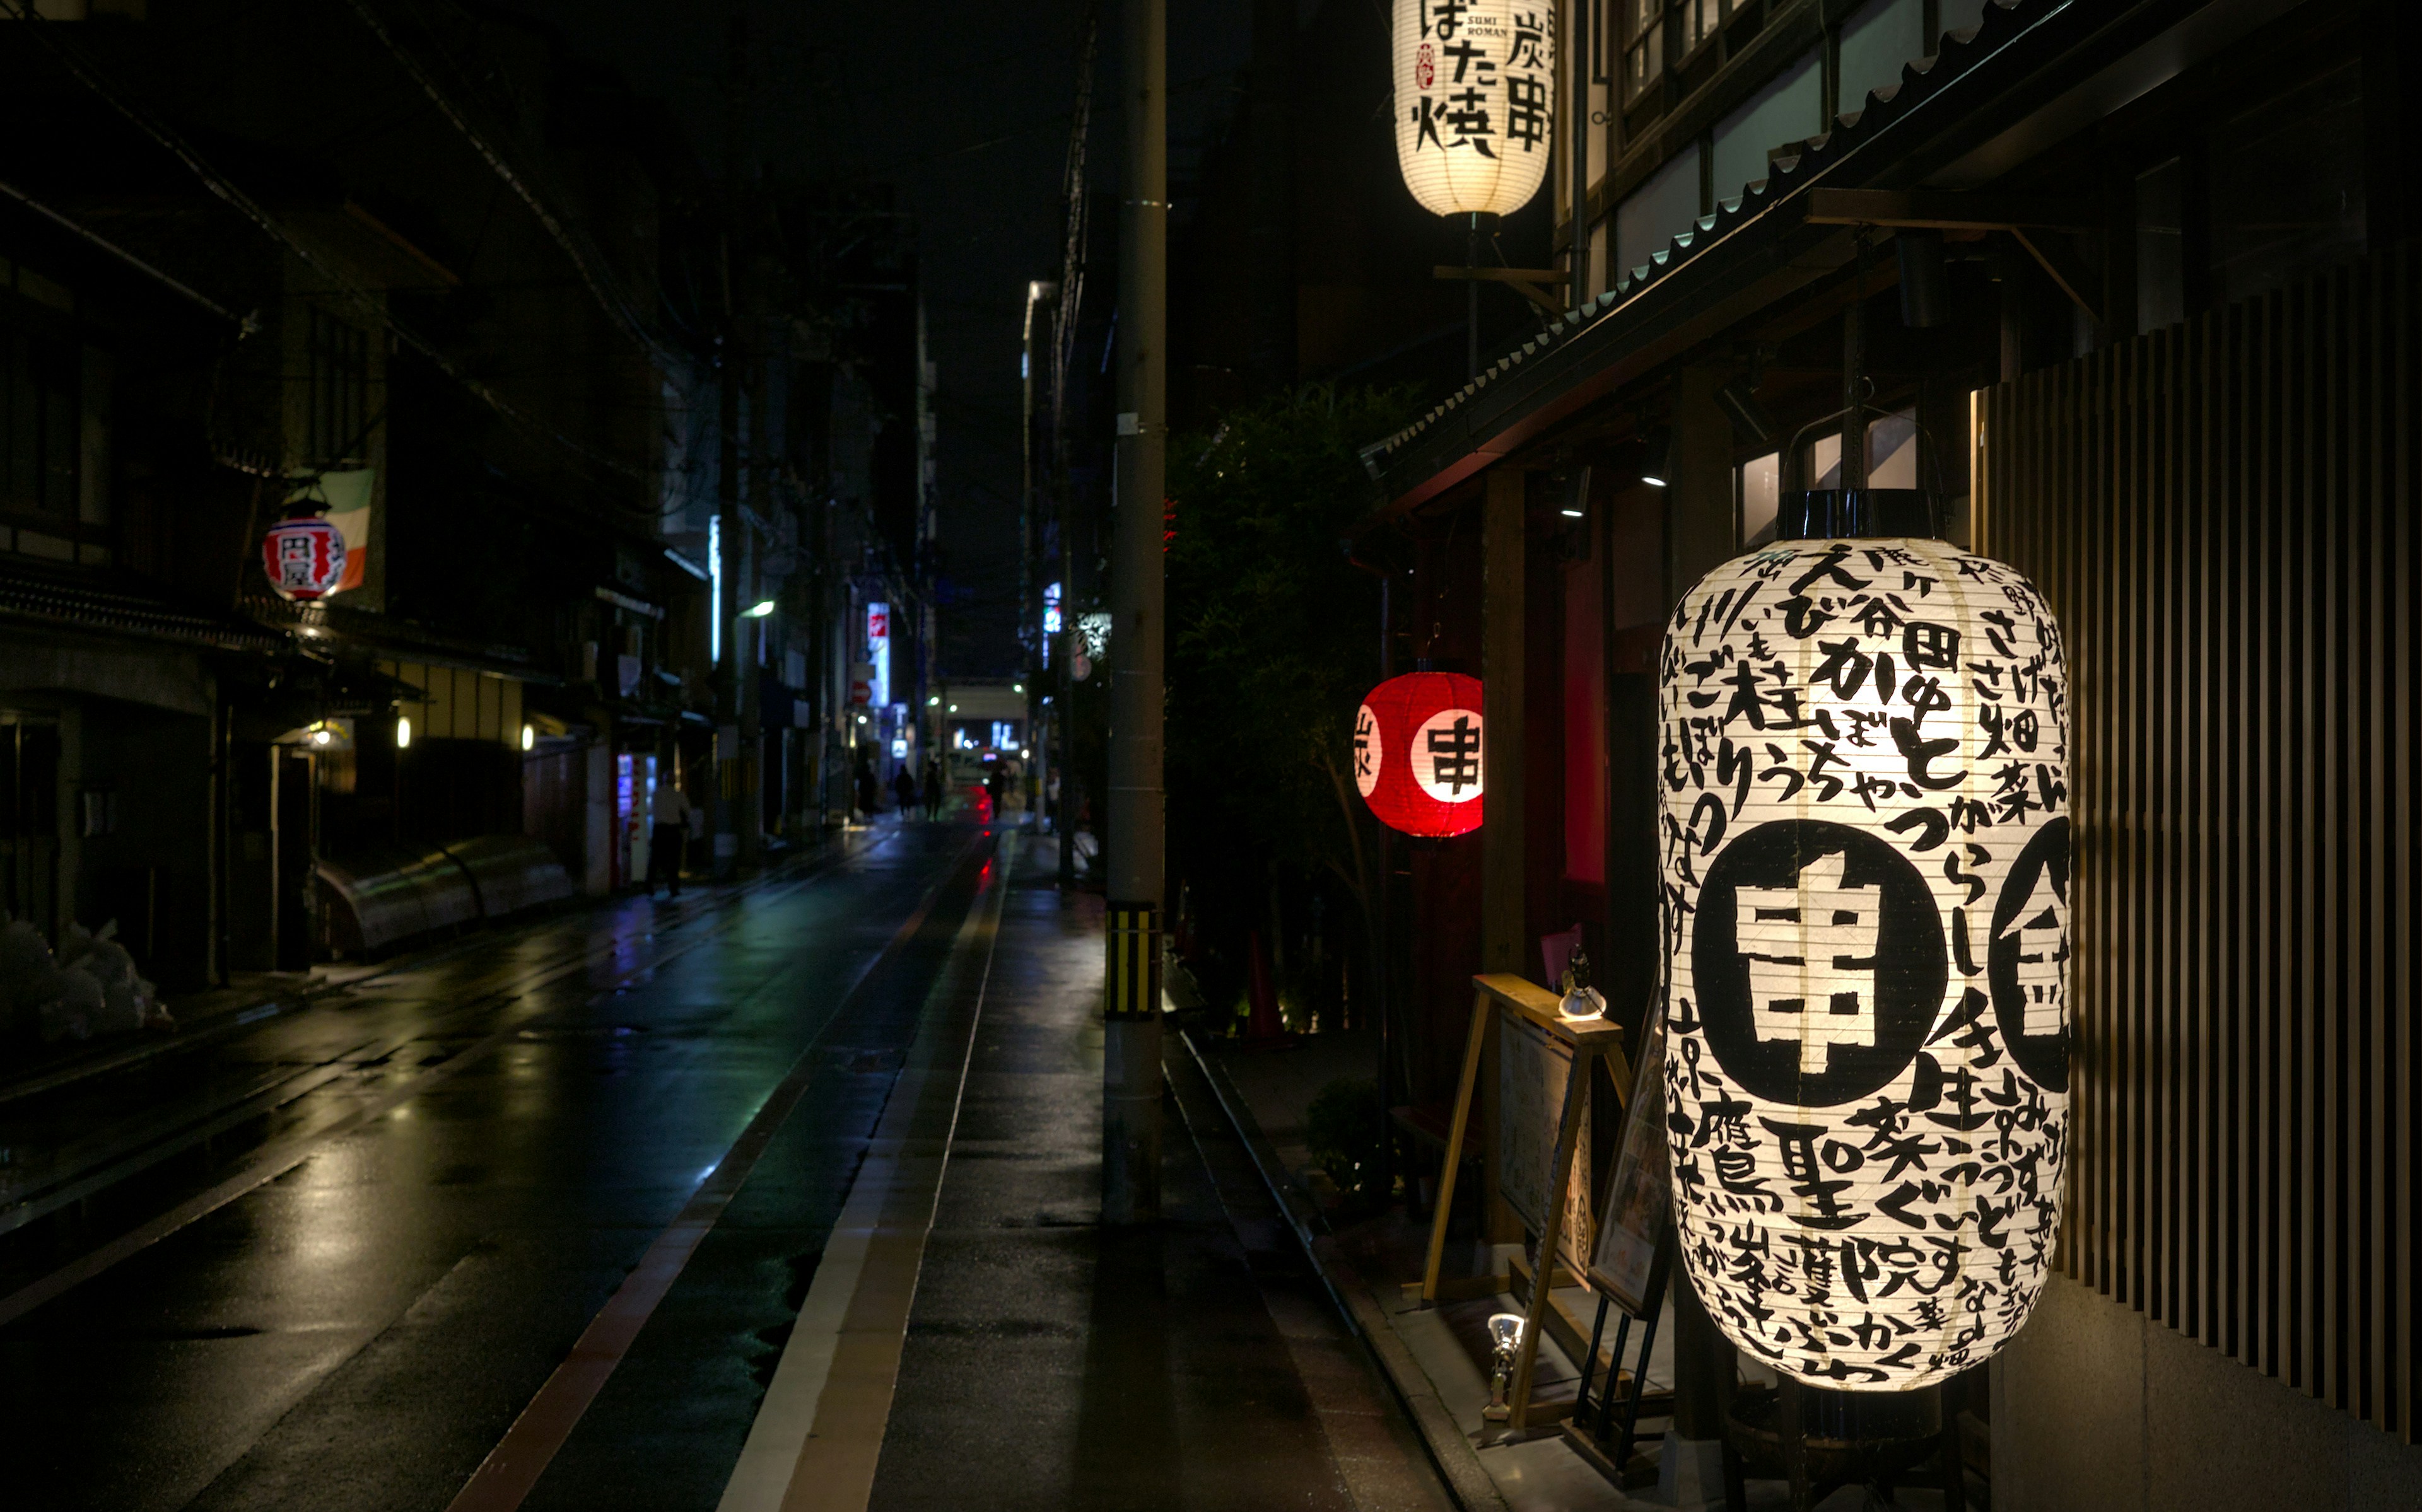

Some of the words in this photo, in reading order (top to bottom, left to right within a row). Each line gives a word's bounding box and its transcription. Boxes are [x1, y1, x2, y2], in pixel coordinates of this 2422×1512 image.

[1467, 16, 1497, 25] SUMI
[1468, 27, 1507, 37] ROMAN
[1505, 11, 1544, 153] 炭串
[1427, 715, 1480, 796] 串
[1735, 849, 1882, 1076] 串
